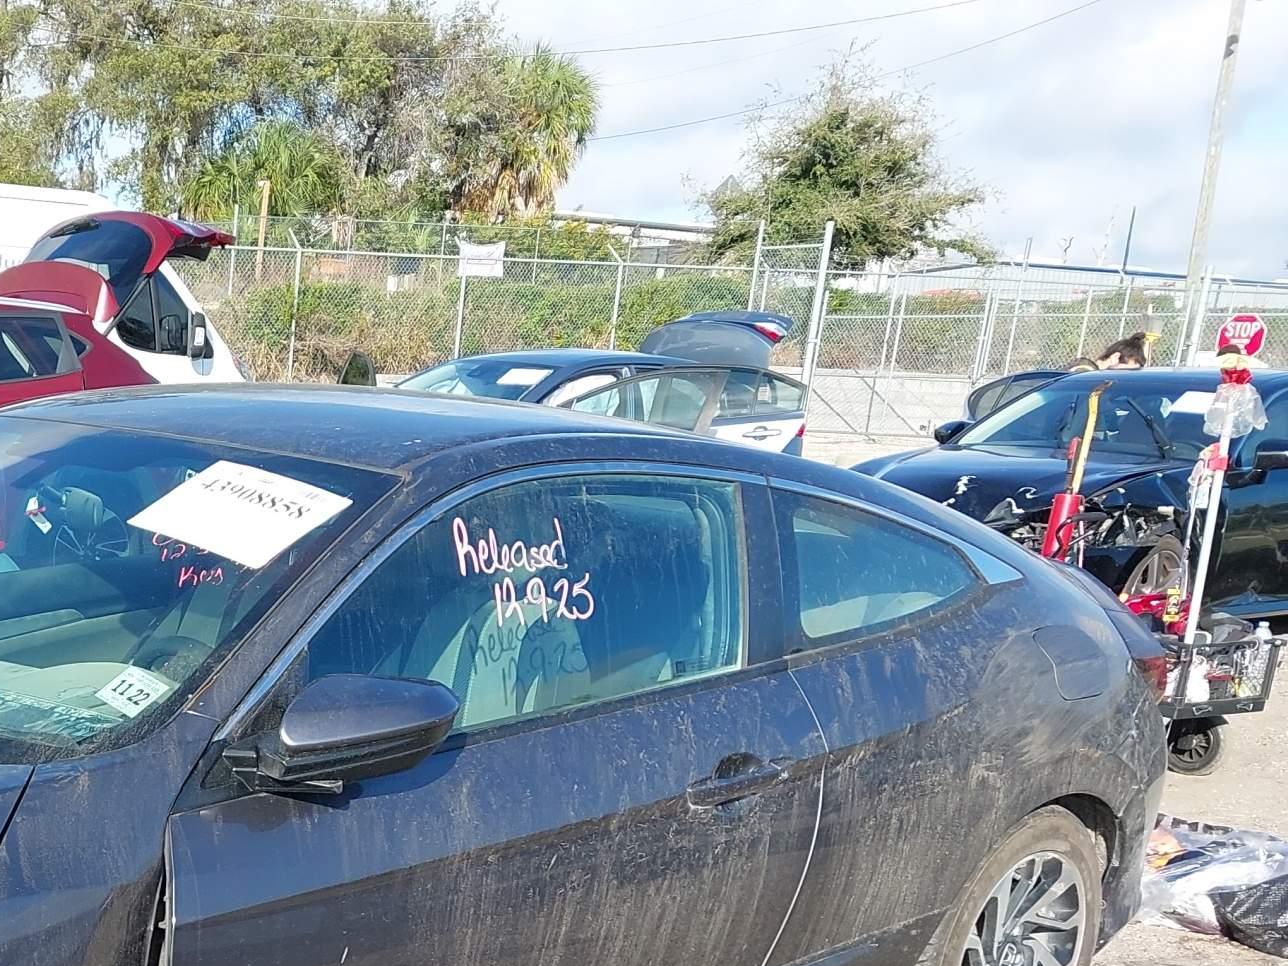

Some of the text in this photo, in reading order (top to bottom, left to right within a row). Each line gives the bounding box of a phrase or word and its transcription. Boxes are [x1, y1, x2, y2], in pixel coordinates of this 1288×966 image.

[1225, 321, 1261, 337] STOP
[201, 478, 311, 519] 43908858
[453, 517, 568, 576] Released
